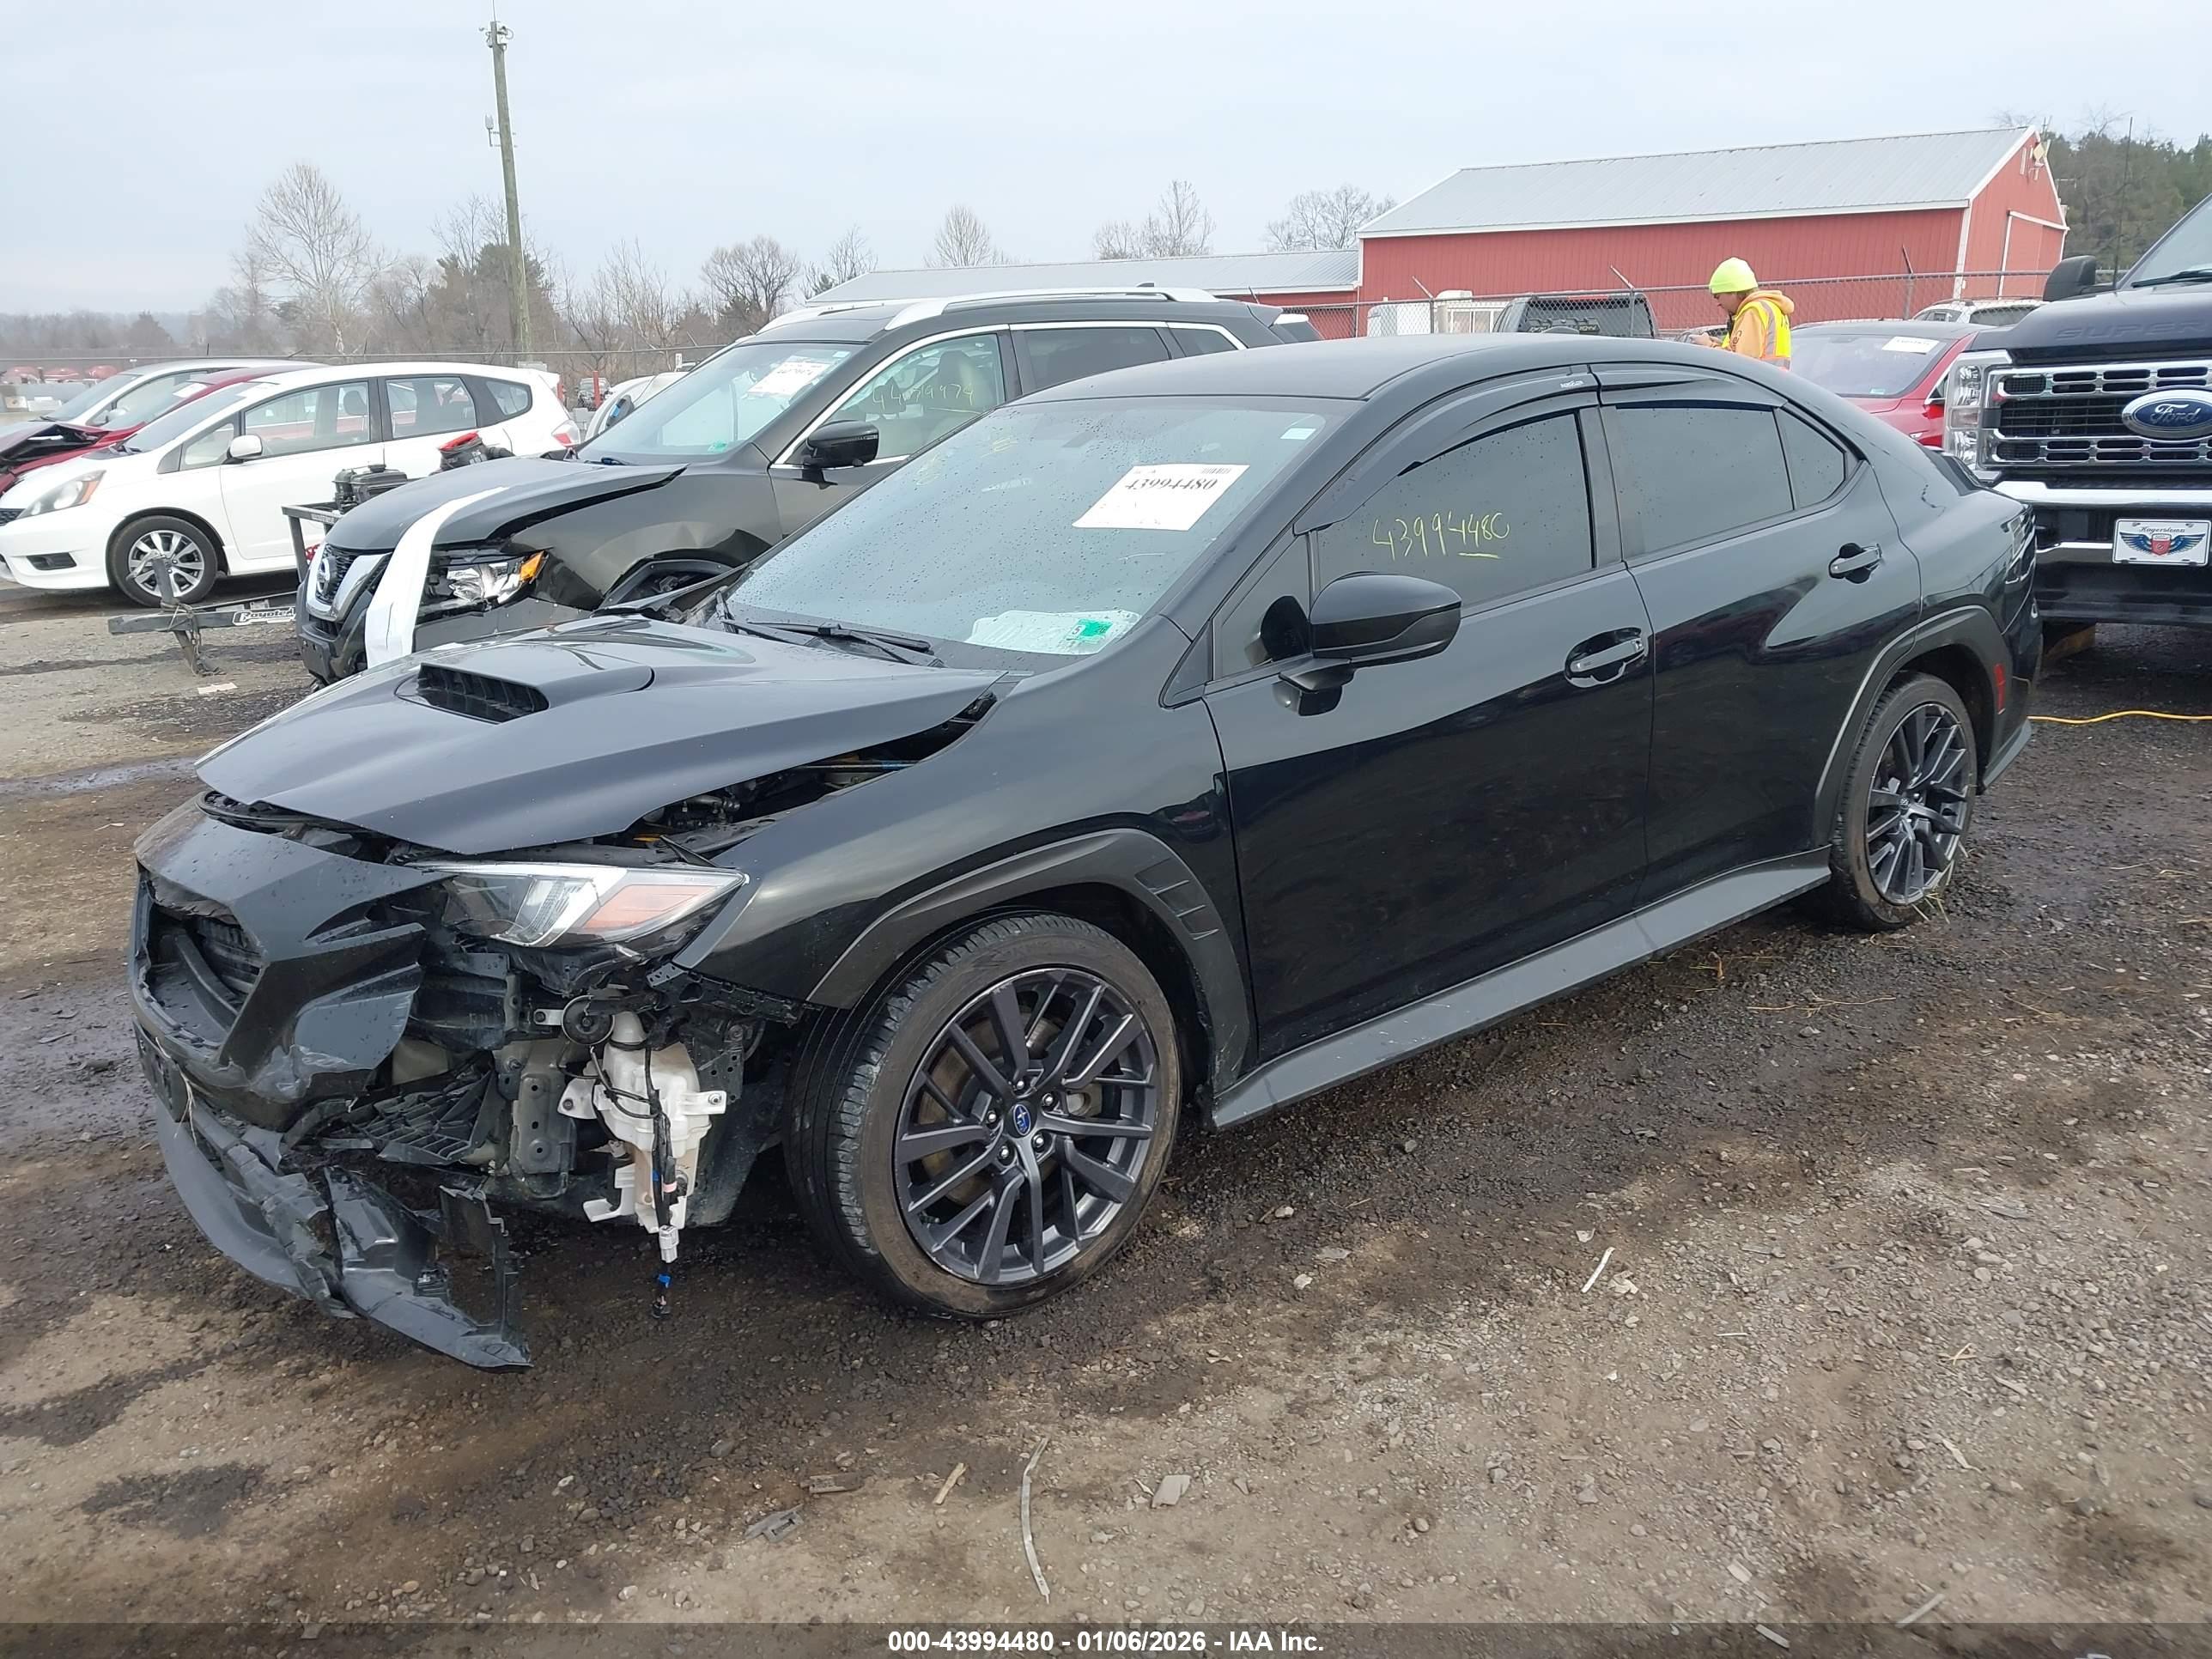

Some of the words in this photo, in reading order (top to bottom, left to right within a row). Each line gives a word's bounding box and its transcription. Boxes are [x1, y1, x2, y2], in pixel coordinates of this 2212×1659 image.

[2055, 320, 2206, 341] SUPER
[2149, 403, 2202, 424] Ford
[1125, 478, 1218, 490] 43994480
[1372, 511, 1510, 561] 43994480
